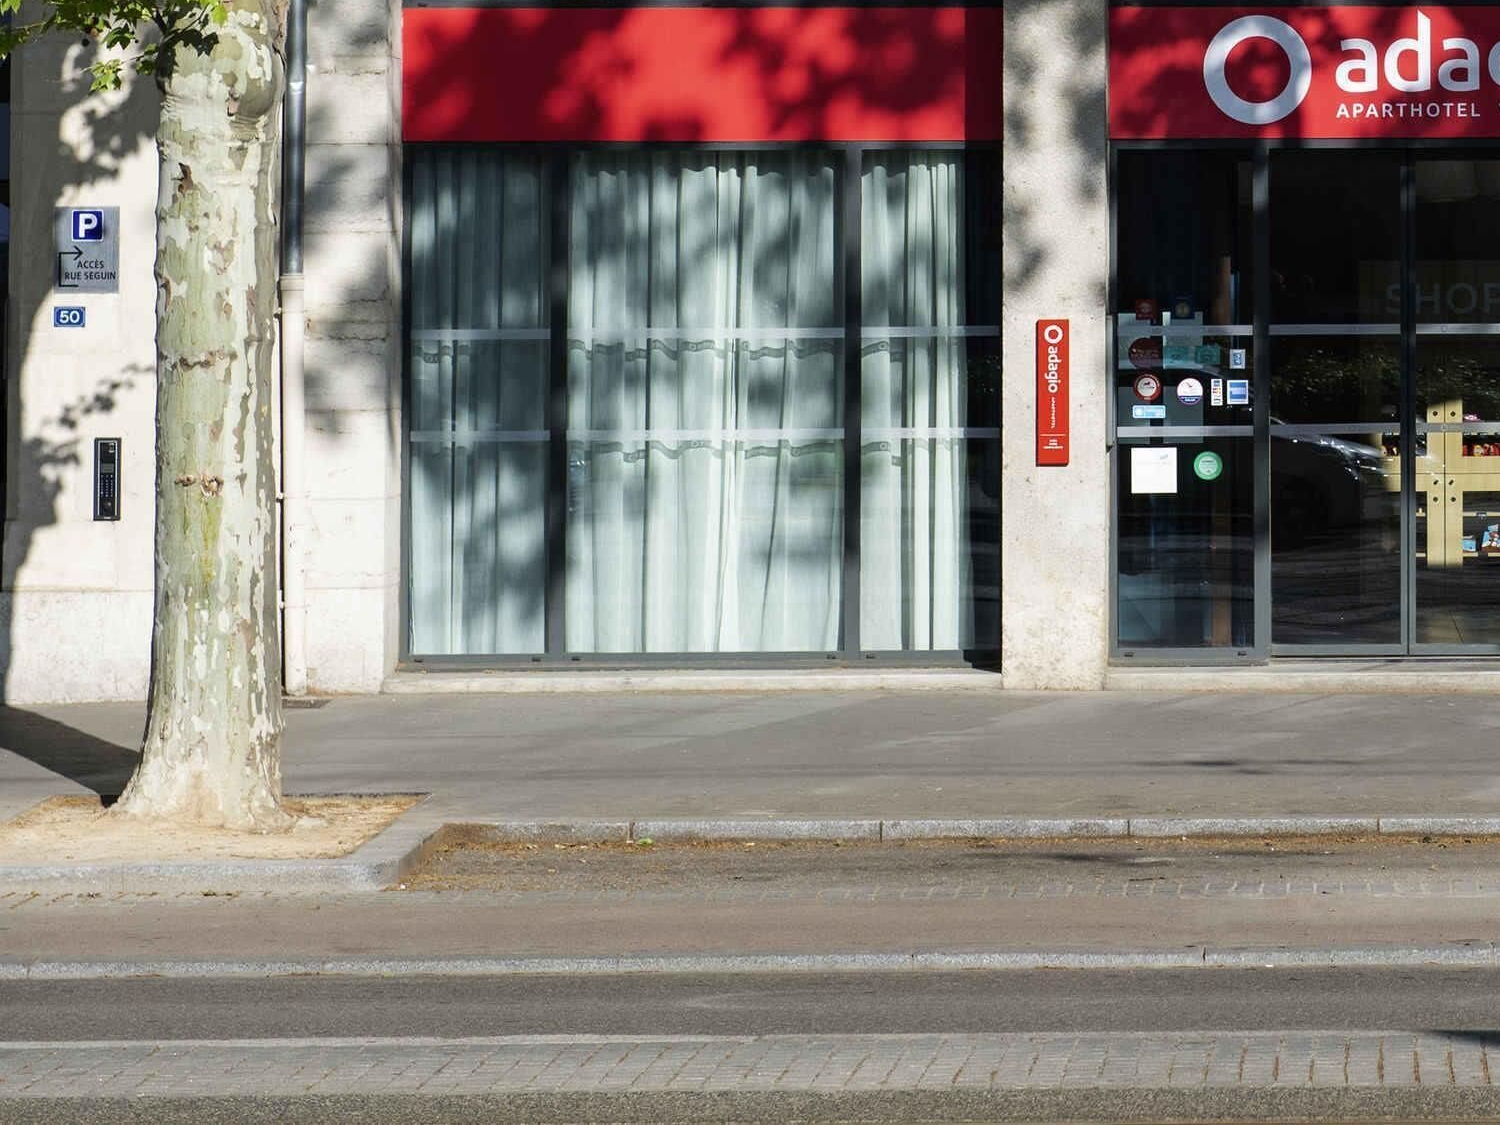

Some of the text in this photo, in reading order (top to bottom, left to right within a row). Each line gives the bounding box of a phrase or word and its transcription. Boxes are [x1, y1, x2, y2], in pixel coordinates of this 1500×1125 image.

[1336, 102, 1481, 118] APARTHOTEL
[78, 213, 98, 238] P
[64, 271, 81, 280] RUE
[59, 310, 80, 324] 50
[1045, 346, 1062, 393] adagio
